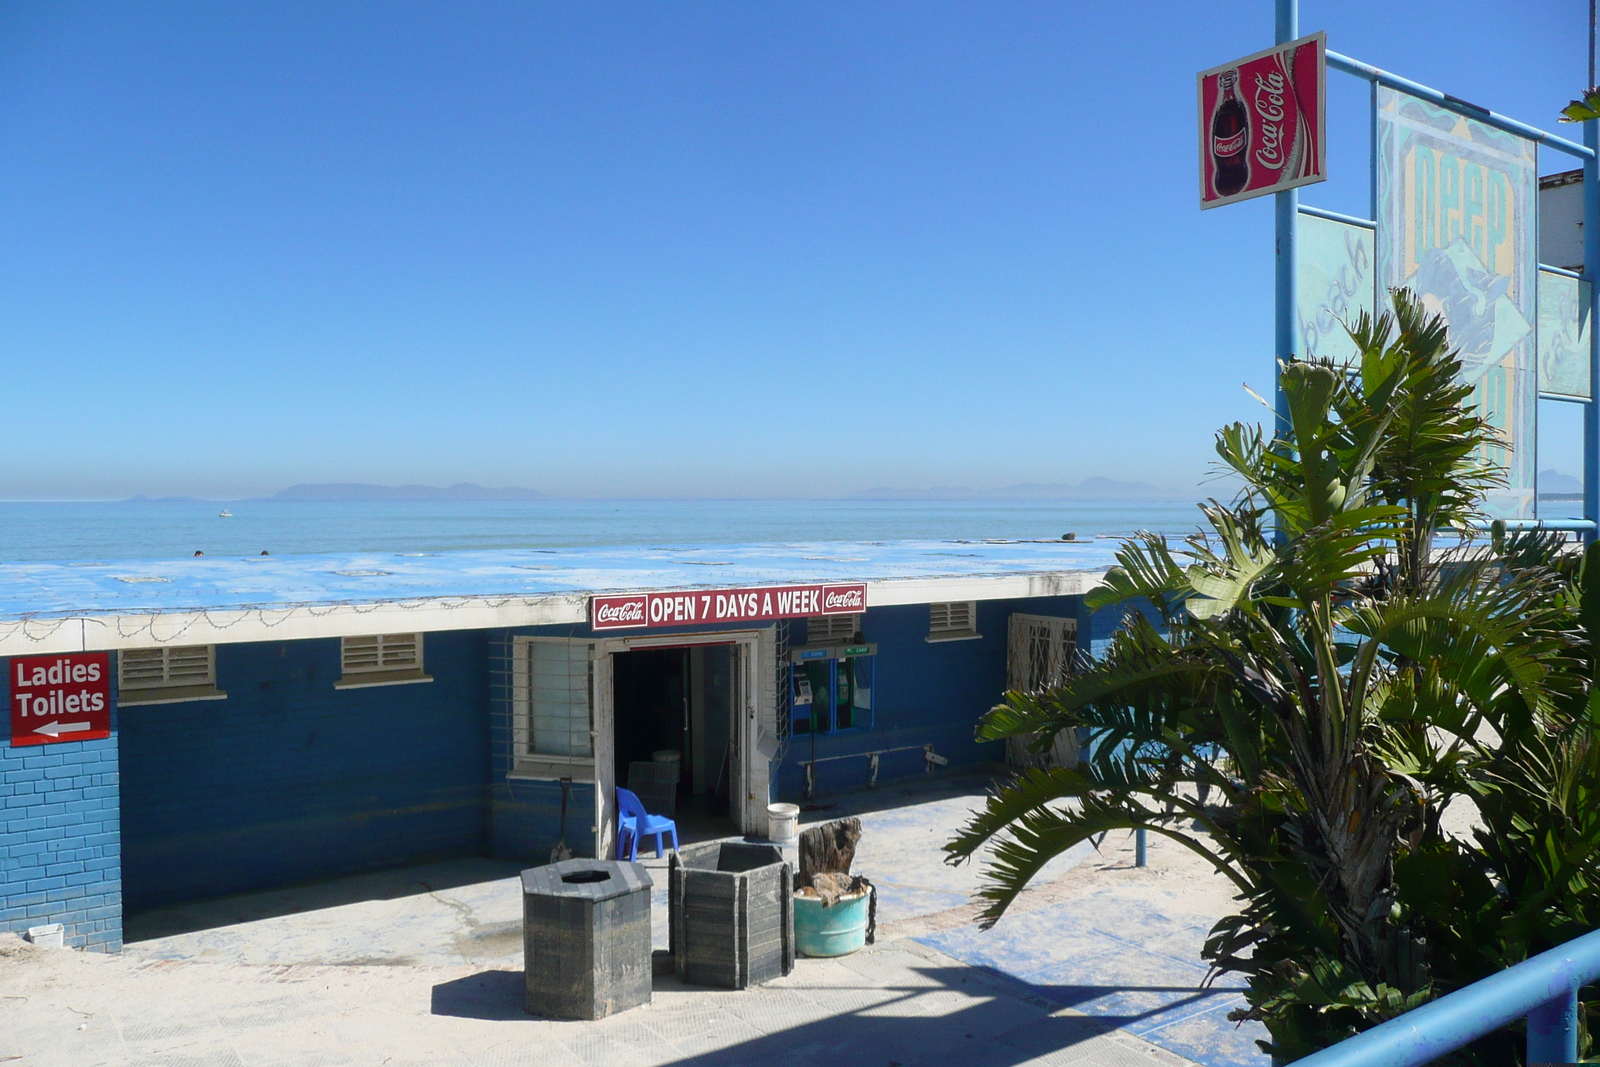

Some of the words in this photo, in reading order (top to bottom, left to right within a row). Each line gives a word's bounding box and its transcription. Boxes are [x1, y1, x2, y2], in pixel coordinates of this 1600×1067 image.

[1255, 70, 1285, 170] Coca-Cola
[597, 602, 644, 622] Coca-Cola
[650, 596, 696, 622] OPEN
[701, 595, 711, 619] 7
[716, 593, 758, 618] DAYS
[761, 592, 773, 616] A
[777, 590, 820, 615] WEEK
[825, 590, 863, 608] Coca-Cola
[17, 659, 101, 687] Ladies
[15, 689, 105, 717] Toilets
